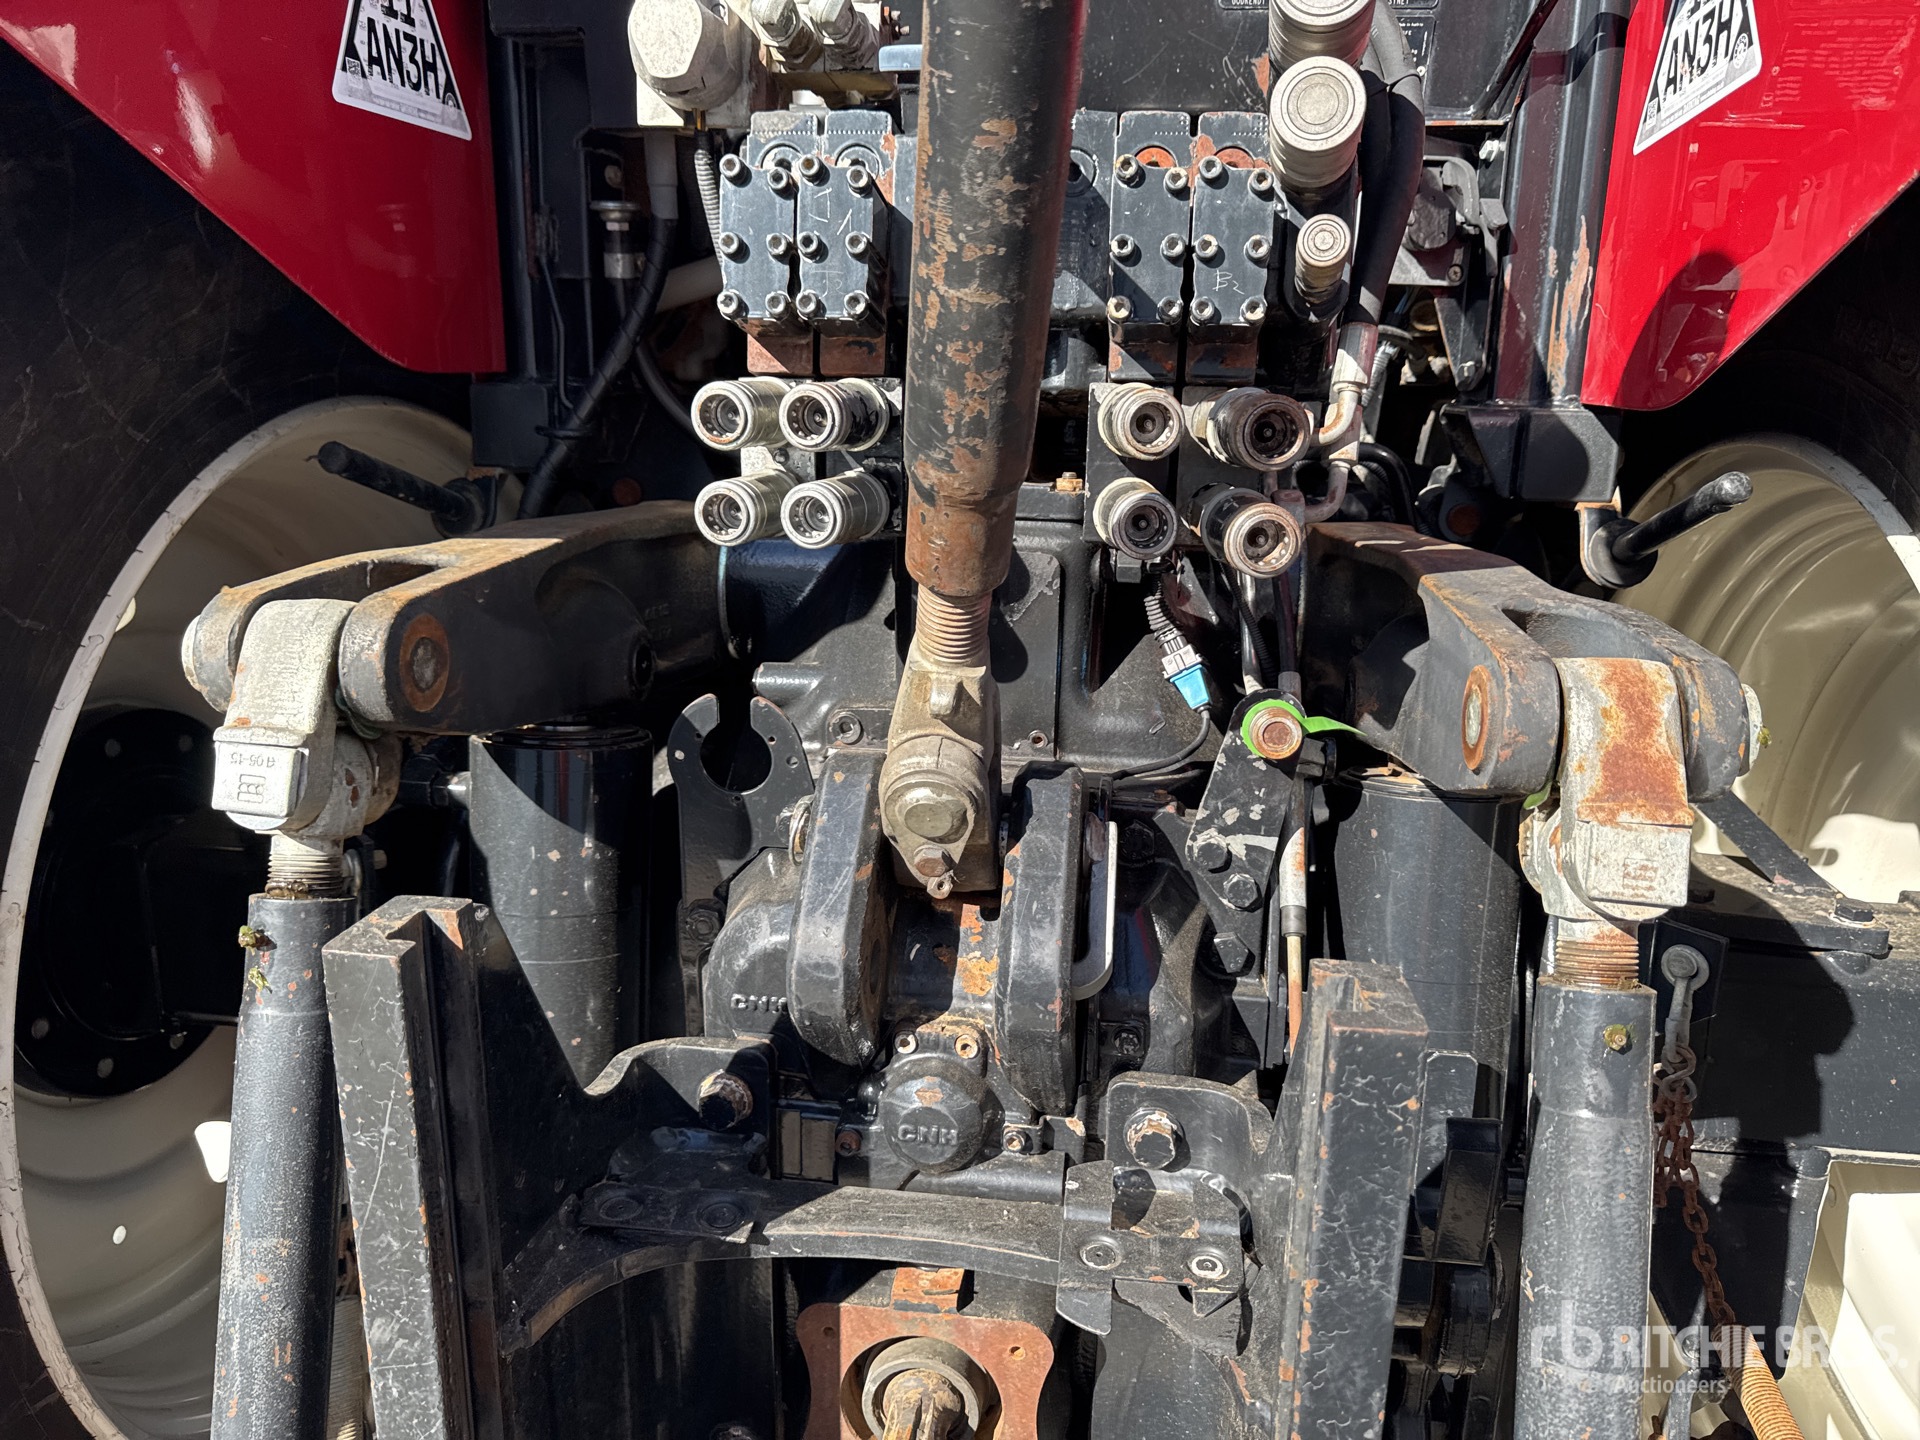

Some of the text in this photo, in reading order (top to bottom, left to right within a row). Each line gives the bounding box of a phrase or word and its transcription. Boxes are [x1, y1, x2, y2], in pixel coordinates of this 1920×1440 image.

[367, 17, 441, 100] AN3H
[1663, 0, 1735, 103] AN3H
[897, 1124, 959, 1146] CNH
